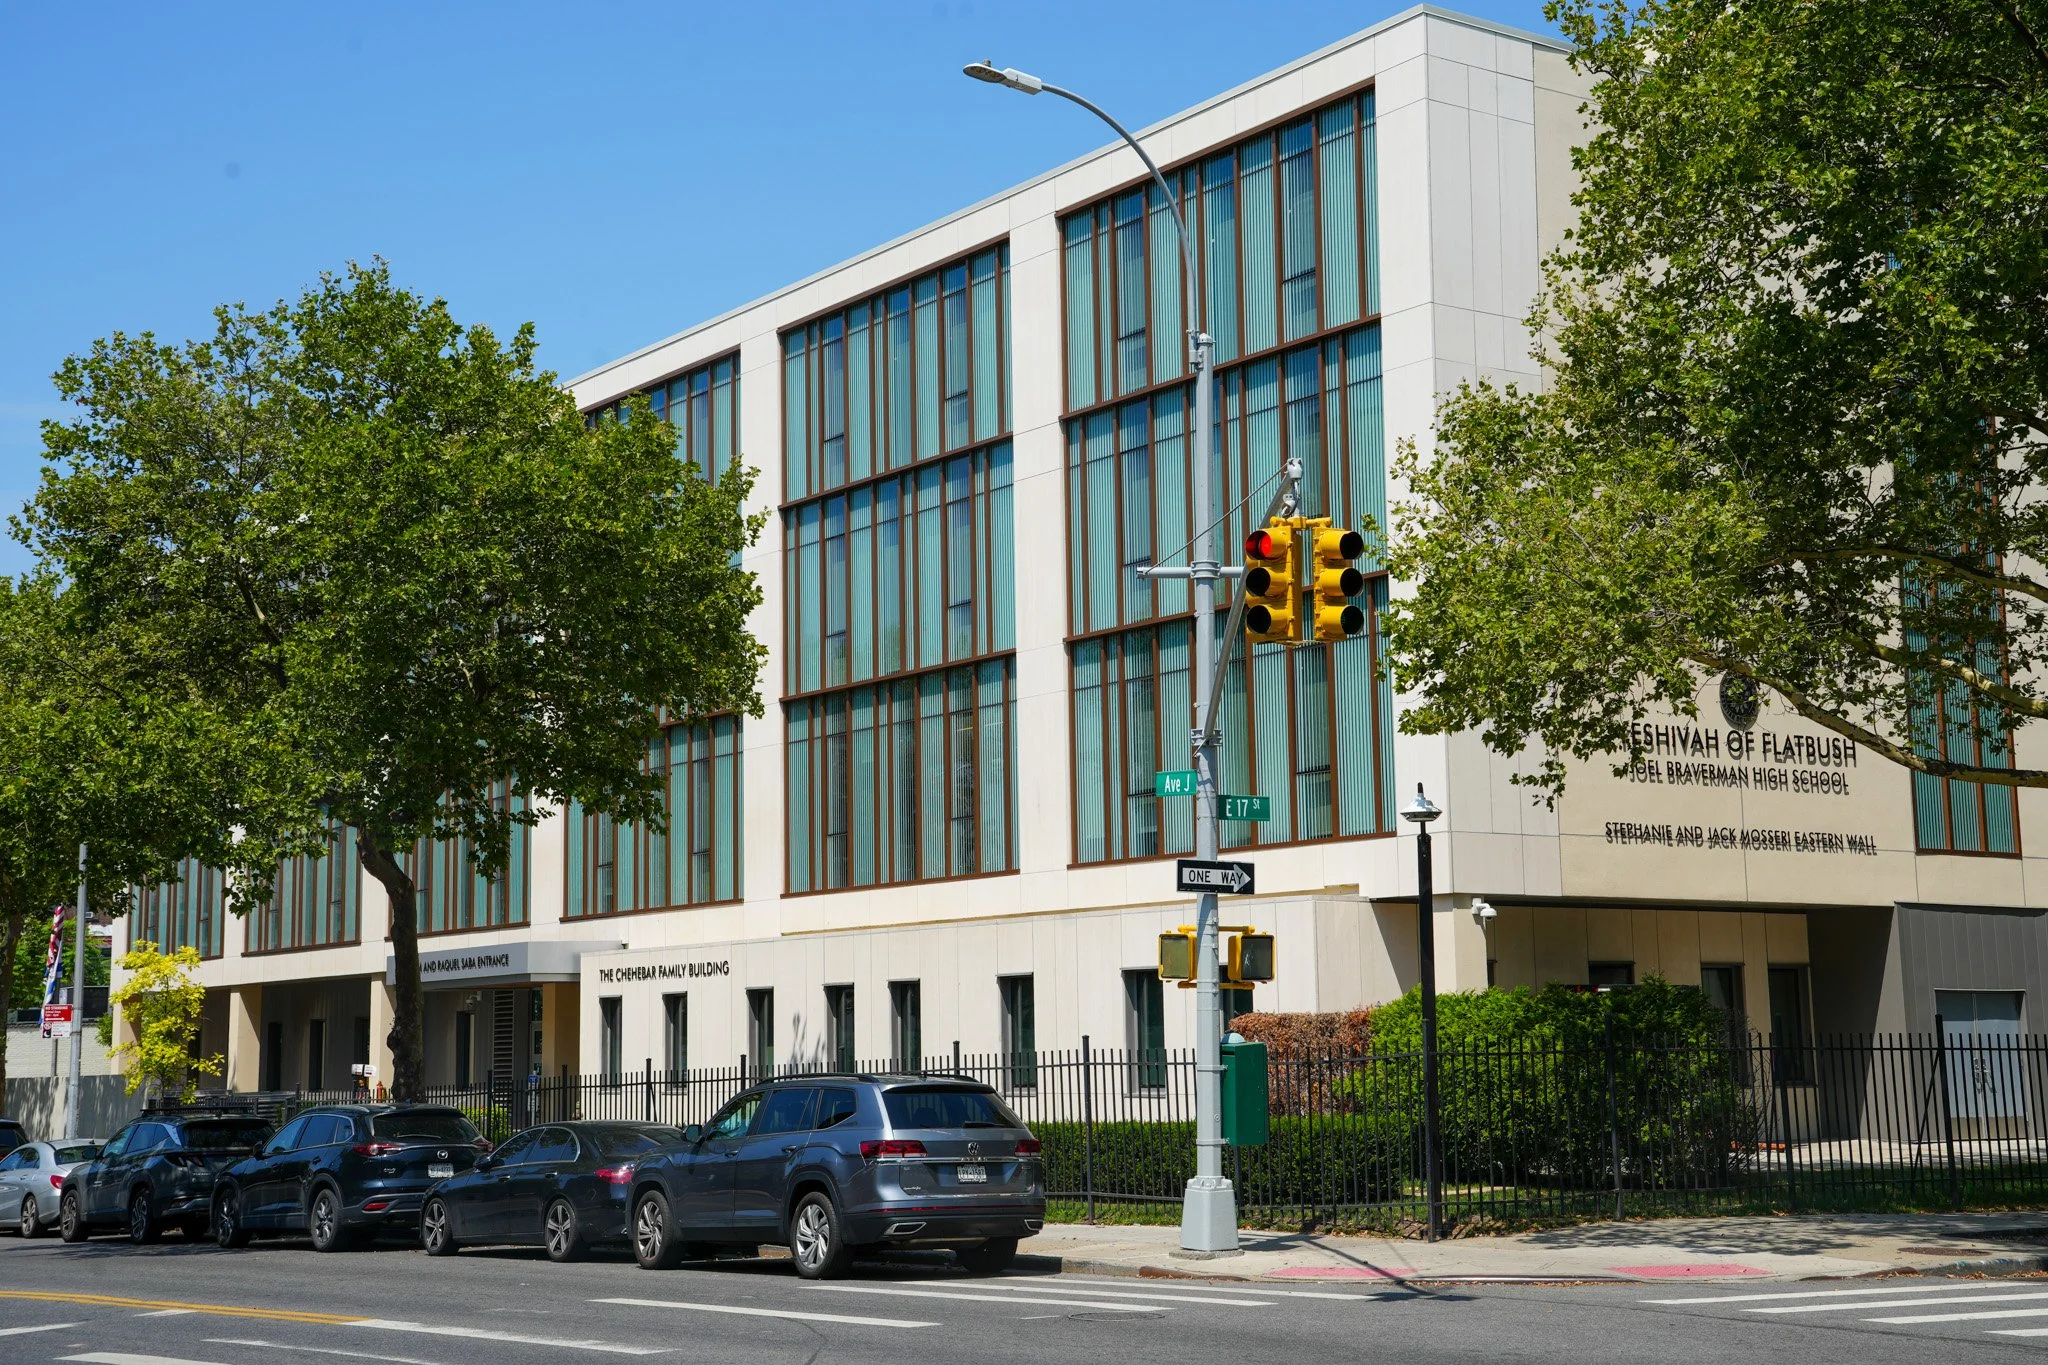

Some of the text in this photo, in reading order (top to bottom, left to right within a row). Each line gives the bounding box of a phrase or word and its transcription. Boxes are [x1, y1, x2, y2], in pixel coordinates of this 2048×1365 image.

[1624, 722, 1857, 760] ESHIVAH OF FLATBUSH
[1164, 774, 1190, 793] Ave J
[1629, 759, 1849, 787] JOEL BRAVERMAN HIGH SCHOOL
[1226, 799, 1232, 817] E
[1237, 799, 1248, 817] 17
[1605, 821, 1877, 849] STEPHANIE AND JACK MOSSERI EASTERN WALL
[1188, 869, 1244, 885] ONE WAY
[423, 961, 436, 974] AND
[437, 958, 460, 973] RAQUEL
[461, 957, 477, 971] SABA
[477, 953, 510, 970] ENTRANCE
[599, 960, 729, 983] THE CHEHEBAR FAMILY BUILDING
